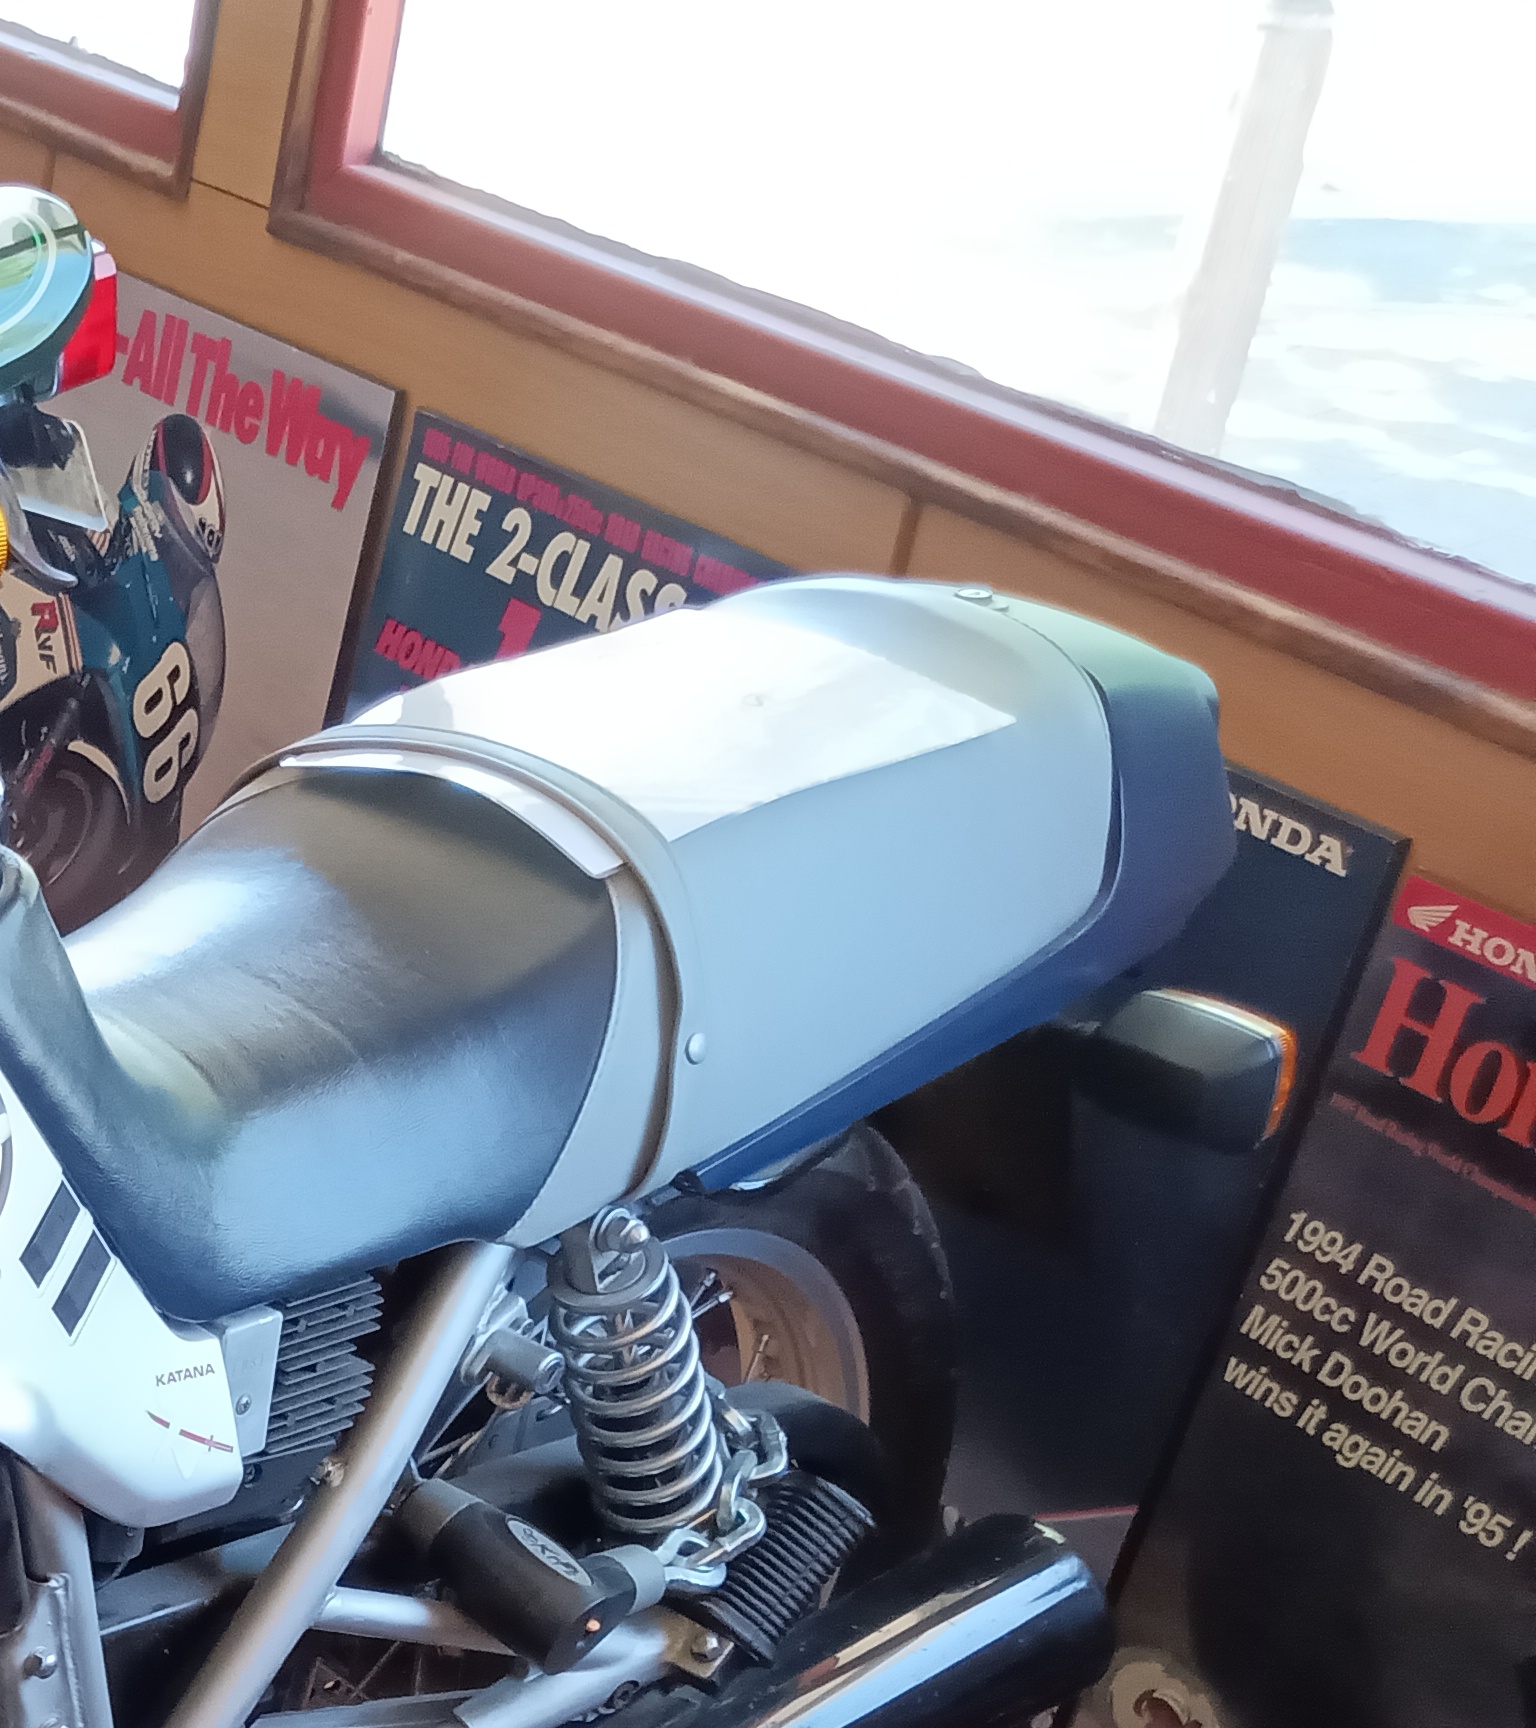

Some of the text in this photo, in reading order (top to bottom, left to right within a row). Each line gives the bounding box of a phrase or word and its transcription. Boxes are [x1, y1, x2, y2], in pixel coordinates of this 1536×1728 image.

[190, 331, 266, 444] The
[265, 369, 372, 511] Way
[403, 462, 492, 563] THE
[1229, 792, 1347, 878] NDA
[1260, 1257, 1357, 1333] 500cc
[1359, 1312, 1466, 1395] World
[1283, 1210, 1364, 1275] 1994
[1357, 1253, 1459, 1329] Road
[155, 1363, 215, 1387] KATANA
[1240, 1304, 1451, 1452] Mick Doohan
[1224, 1355, 1299, 1418] wins
[1296, 1398, 1328, 1436] it
[1322, 1421, 1417, 1493] again
[1414, 1471, 1455, 1516] in
[1459, 1495, 1514, 1548] '95
